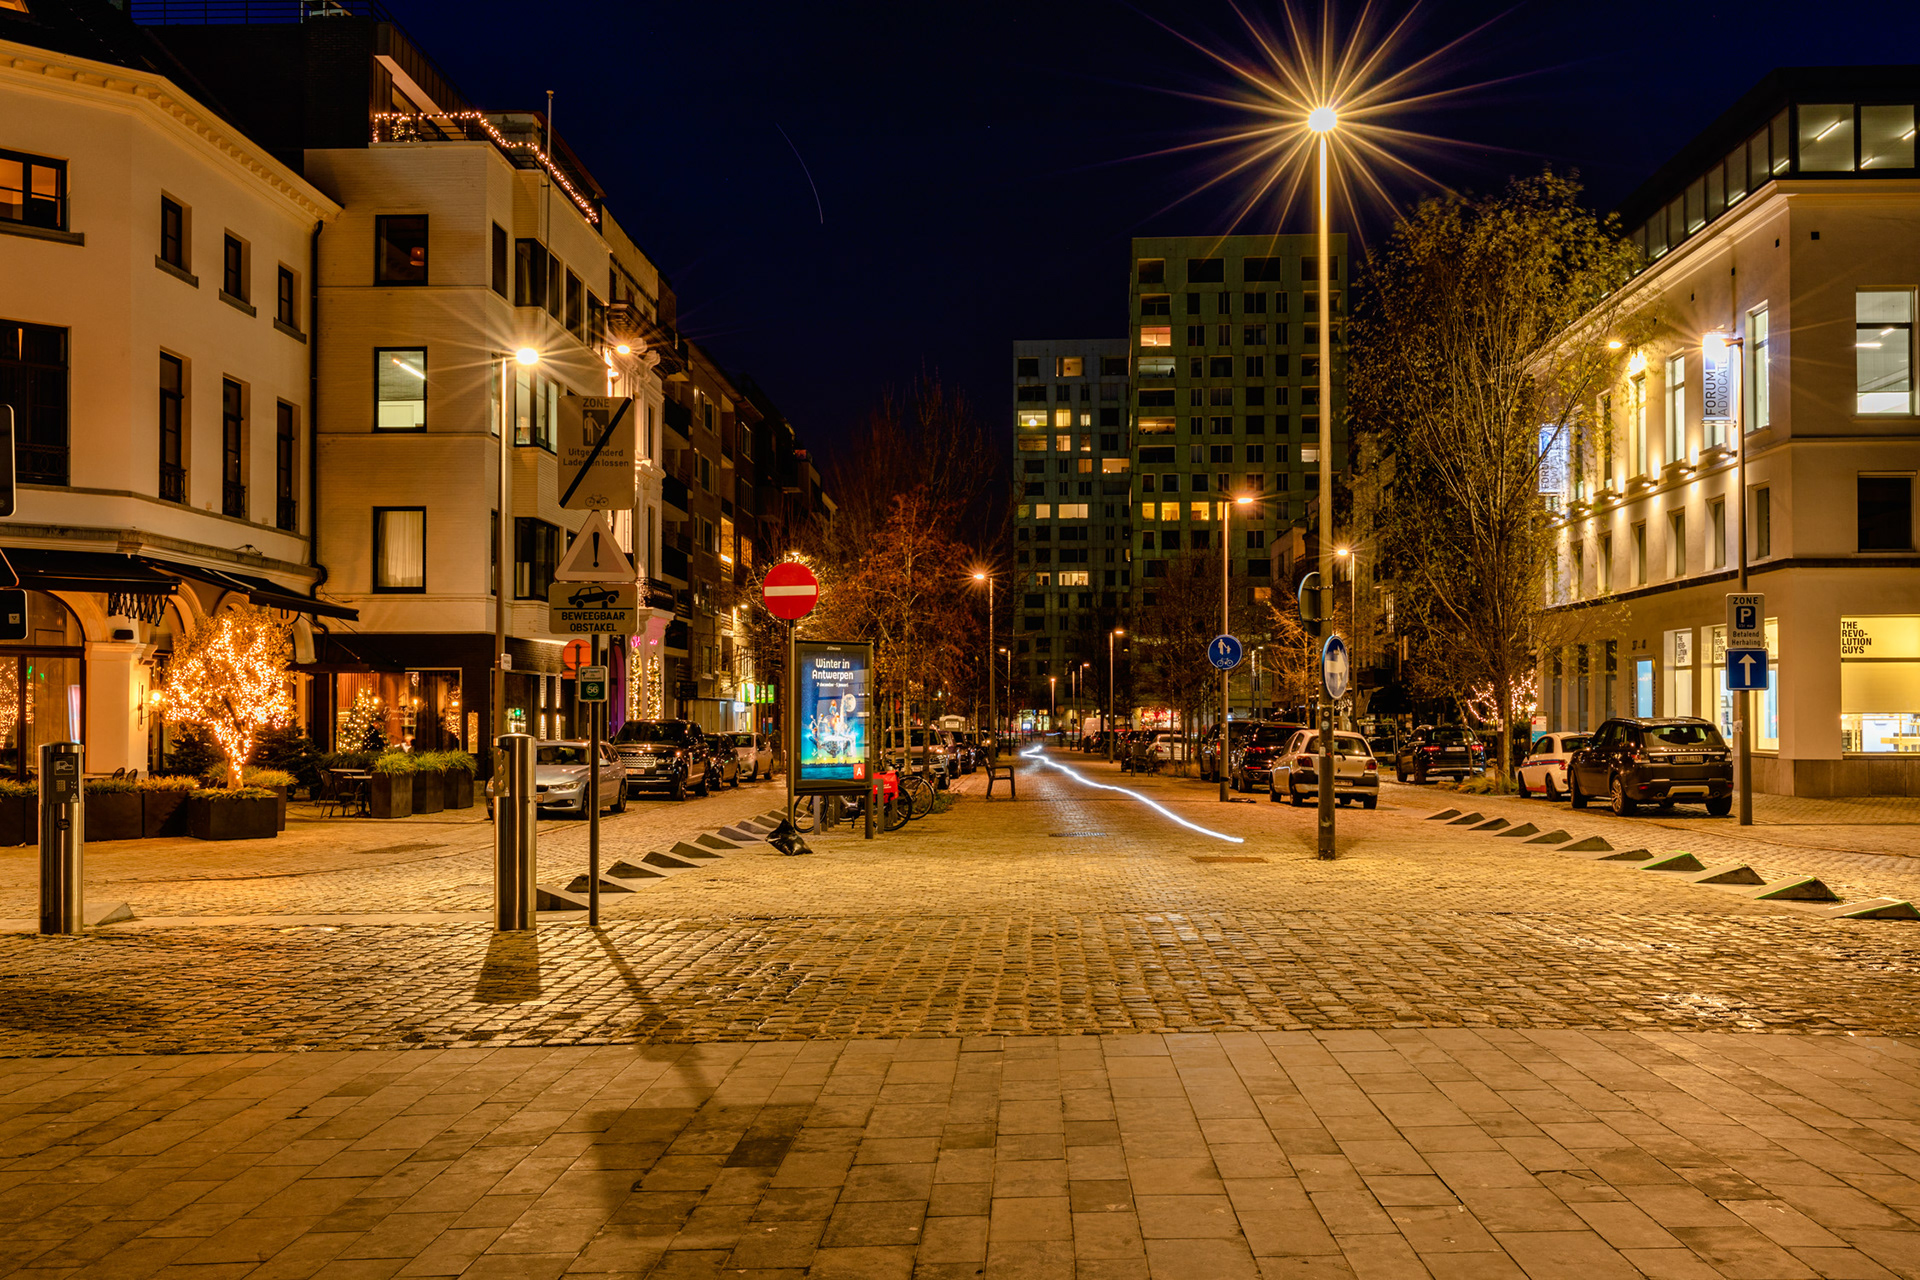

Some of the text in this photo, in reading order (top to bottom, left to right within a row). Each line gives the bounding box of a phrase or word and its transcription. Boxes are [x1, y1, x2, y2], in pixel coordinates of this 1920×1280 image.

[1705, 371, 1716, 416] FORUM
[582, 397, 610, 408] ZONE
[567, 448, 624, 458] Uitgenderd
[602, 459, 629, 467] lossen
[1733, 597, 1759, 605] ZONE
[561, 611, 626, 621] BEWEEGBAAR
[1740, 608, 1752, 623] P
[569, 623, 617, 632] OBSTAKEL
[1841, 621, 1858, 629] THE
[1732, 630, 1760, 638] Betalend
[1841, 629, 1868, 638] REVO-
[1731, 639, 1761, 647] Herhaling
[1841, 637, 1872, 646] LUTION
[1841, 646, 1865, 654] GUYS
[815, 658, 850, 669] Winter in
[812, 669, 854, 682] Antwerpen
[587, 685, 599, 694] 56
[856, 767, 863, 776] A
